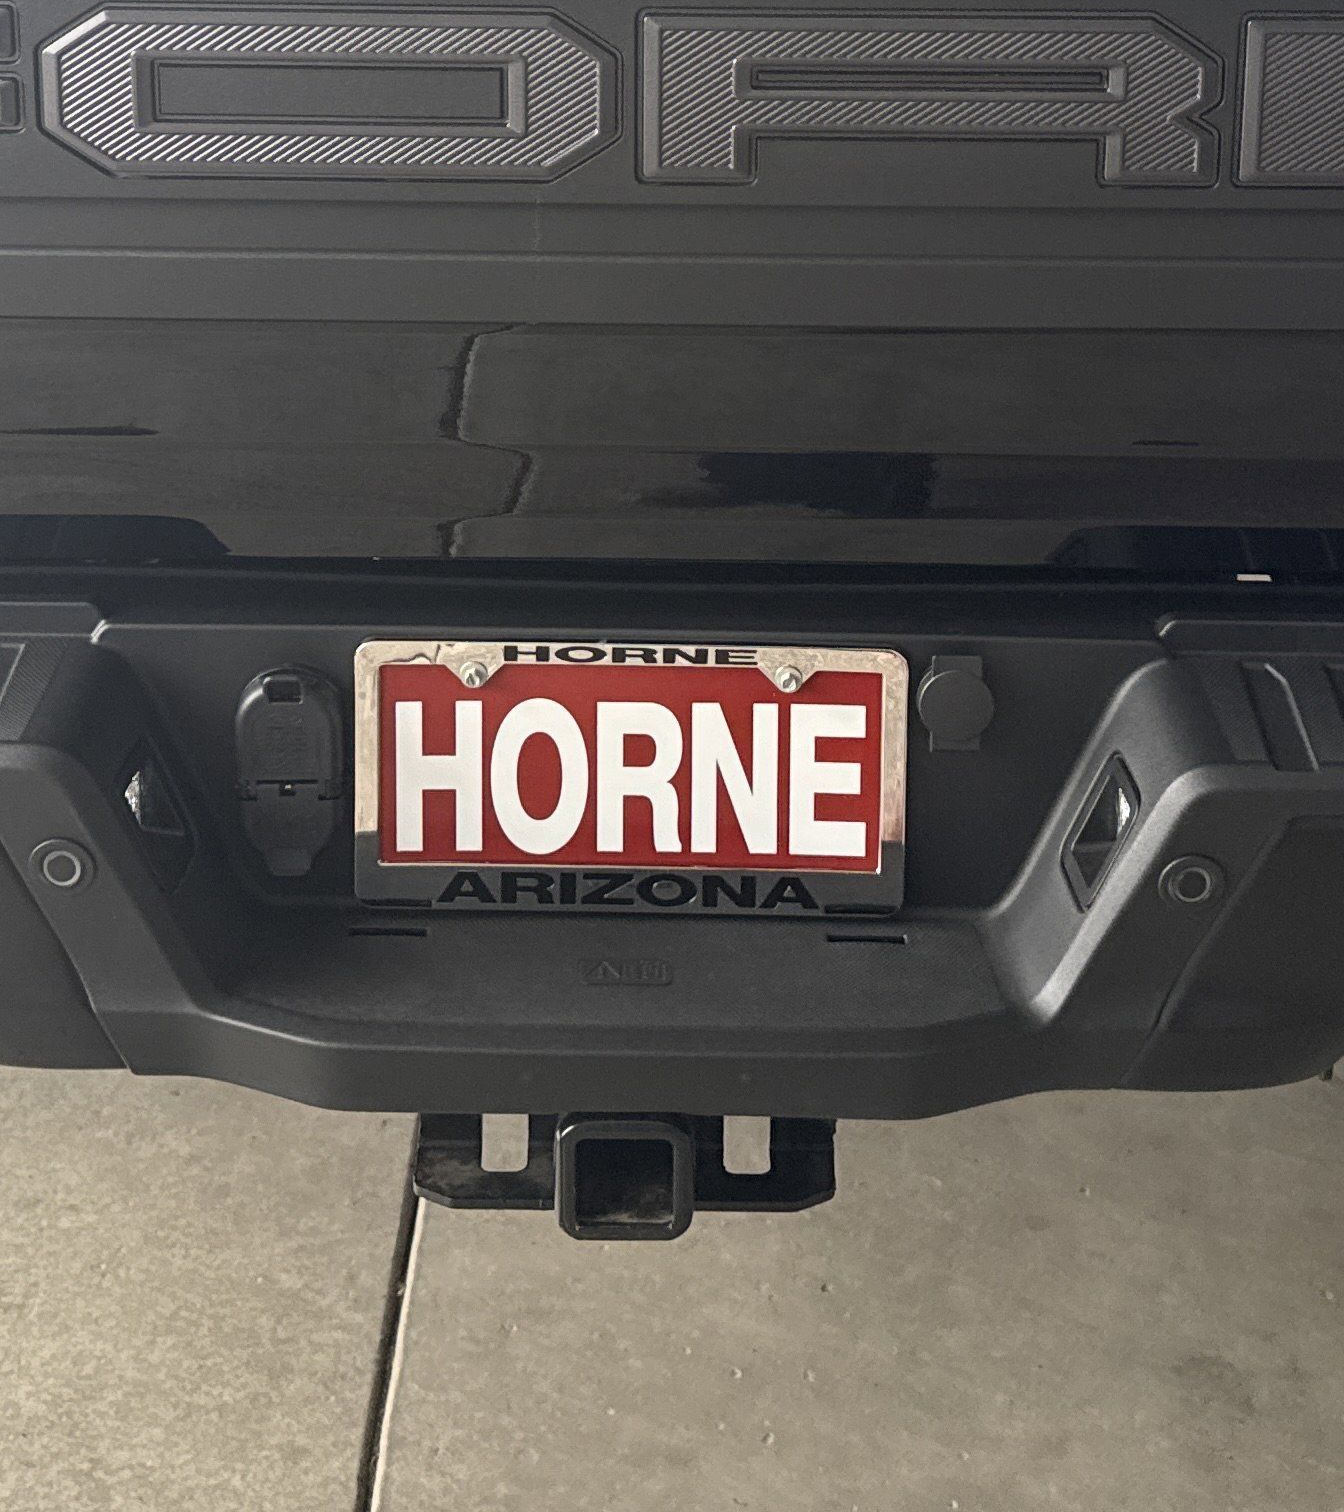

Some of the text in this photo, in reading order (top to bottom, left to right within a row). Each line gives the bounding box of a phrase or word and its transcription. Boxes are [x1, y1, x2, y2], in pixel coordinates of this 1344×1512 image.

[503, 644, 758, 666] HORNE
[394, 697, 867, 857] HORNE
[436, 870, 819, 910] ARIZONA
